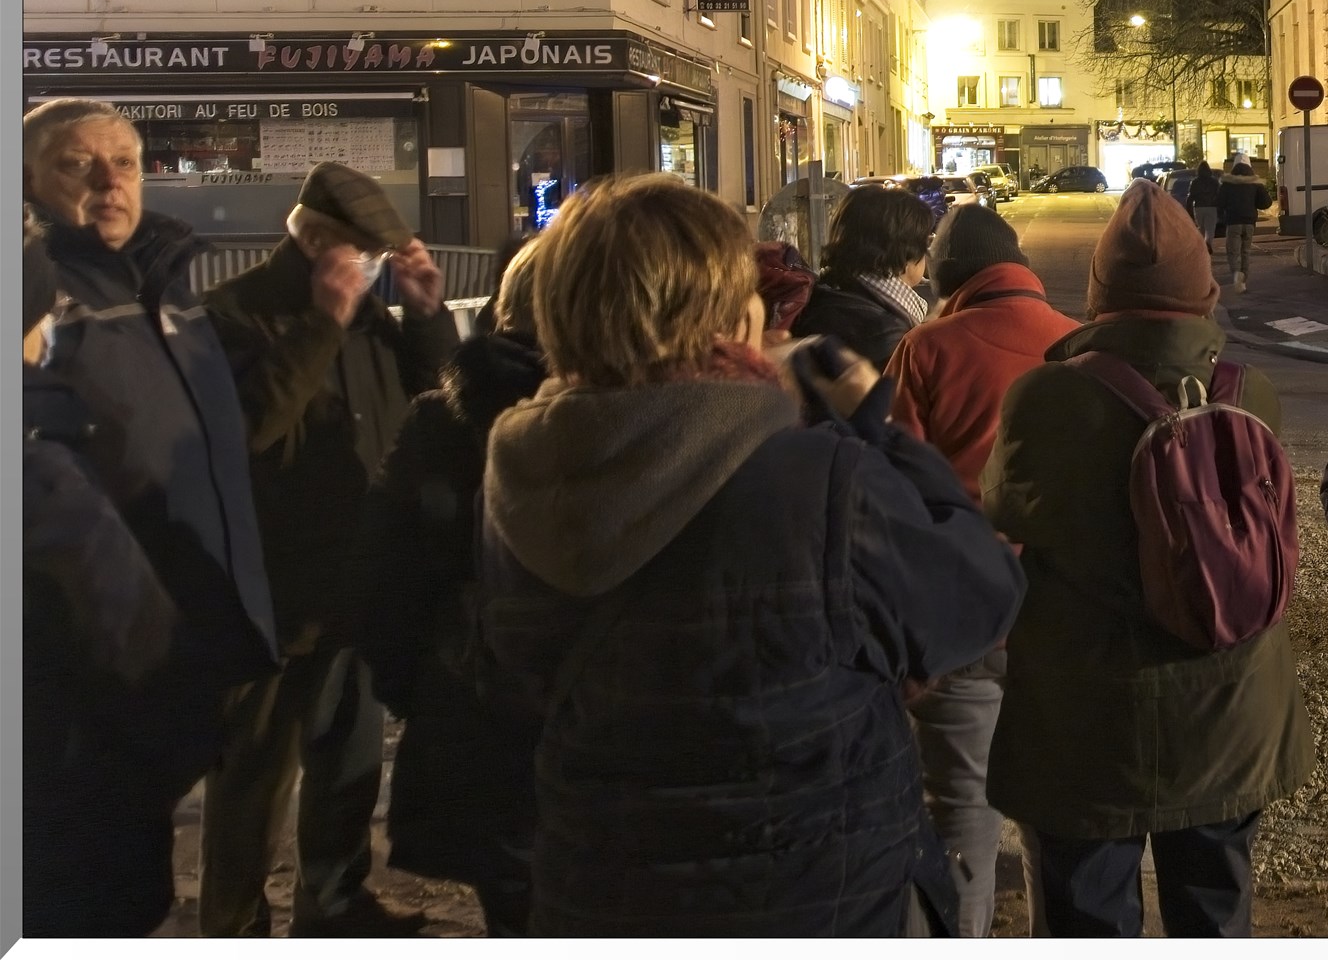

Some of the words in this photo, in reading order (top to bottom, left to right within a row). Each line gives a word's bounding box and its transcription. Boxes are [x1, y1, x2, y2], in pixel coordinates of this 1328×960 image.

[23, 47, 229, 68] RESTAURANT
[258, 43, 436, 71] FUJIYAMA
[462, 44, 613, 65] JAPONAIS
[195, 103, 216, 117] AU
[229, 103, 257, 117] FEU
[270, 103, 290, 117] DE
[302, 102, 338, 117] BOIS
